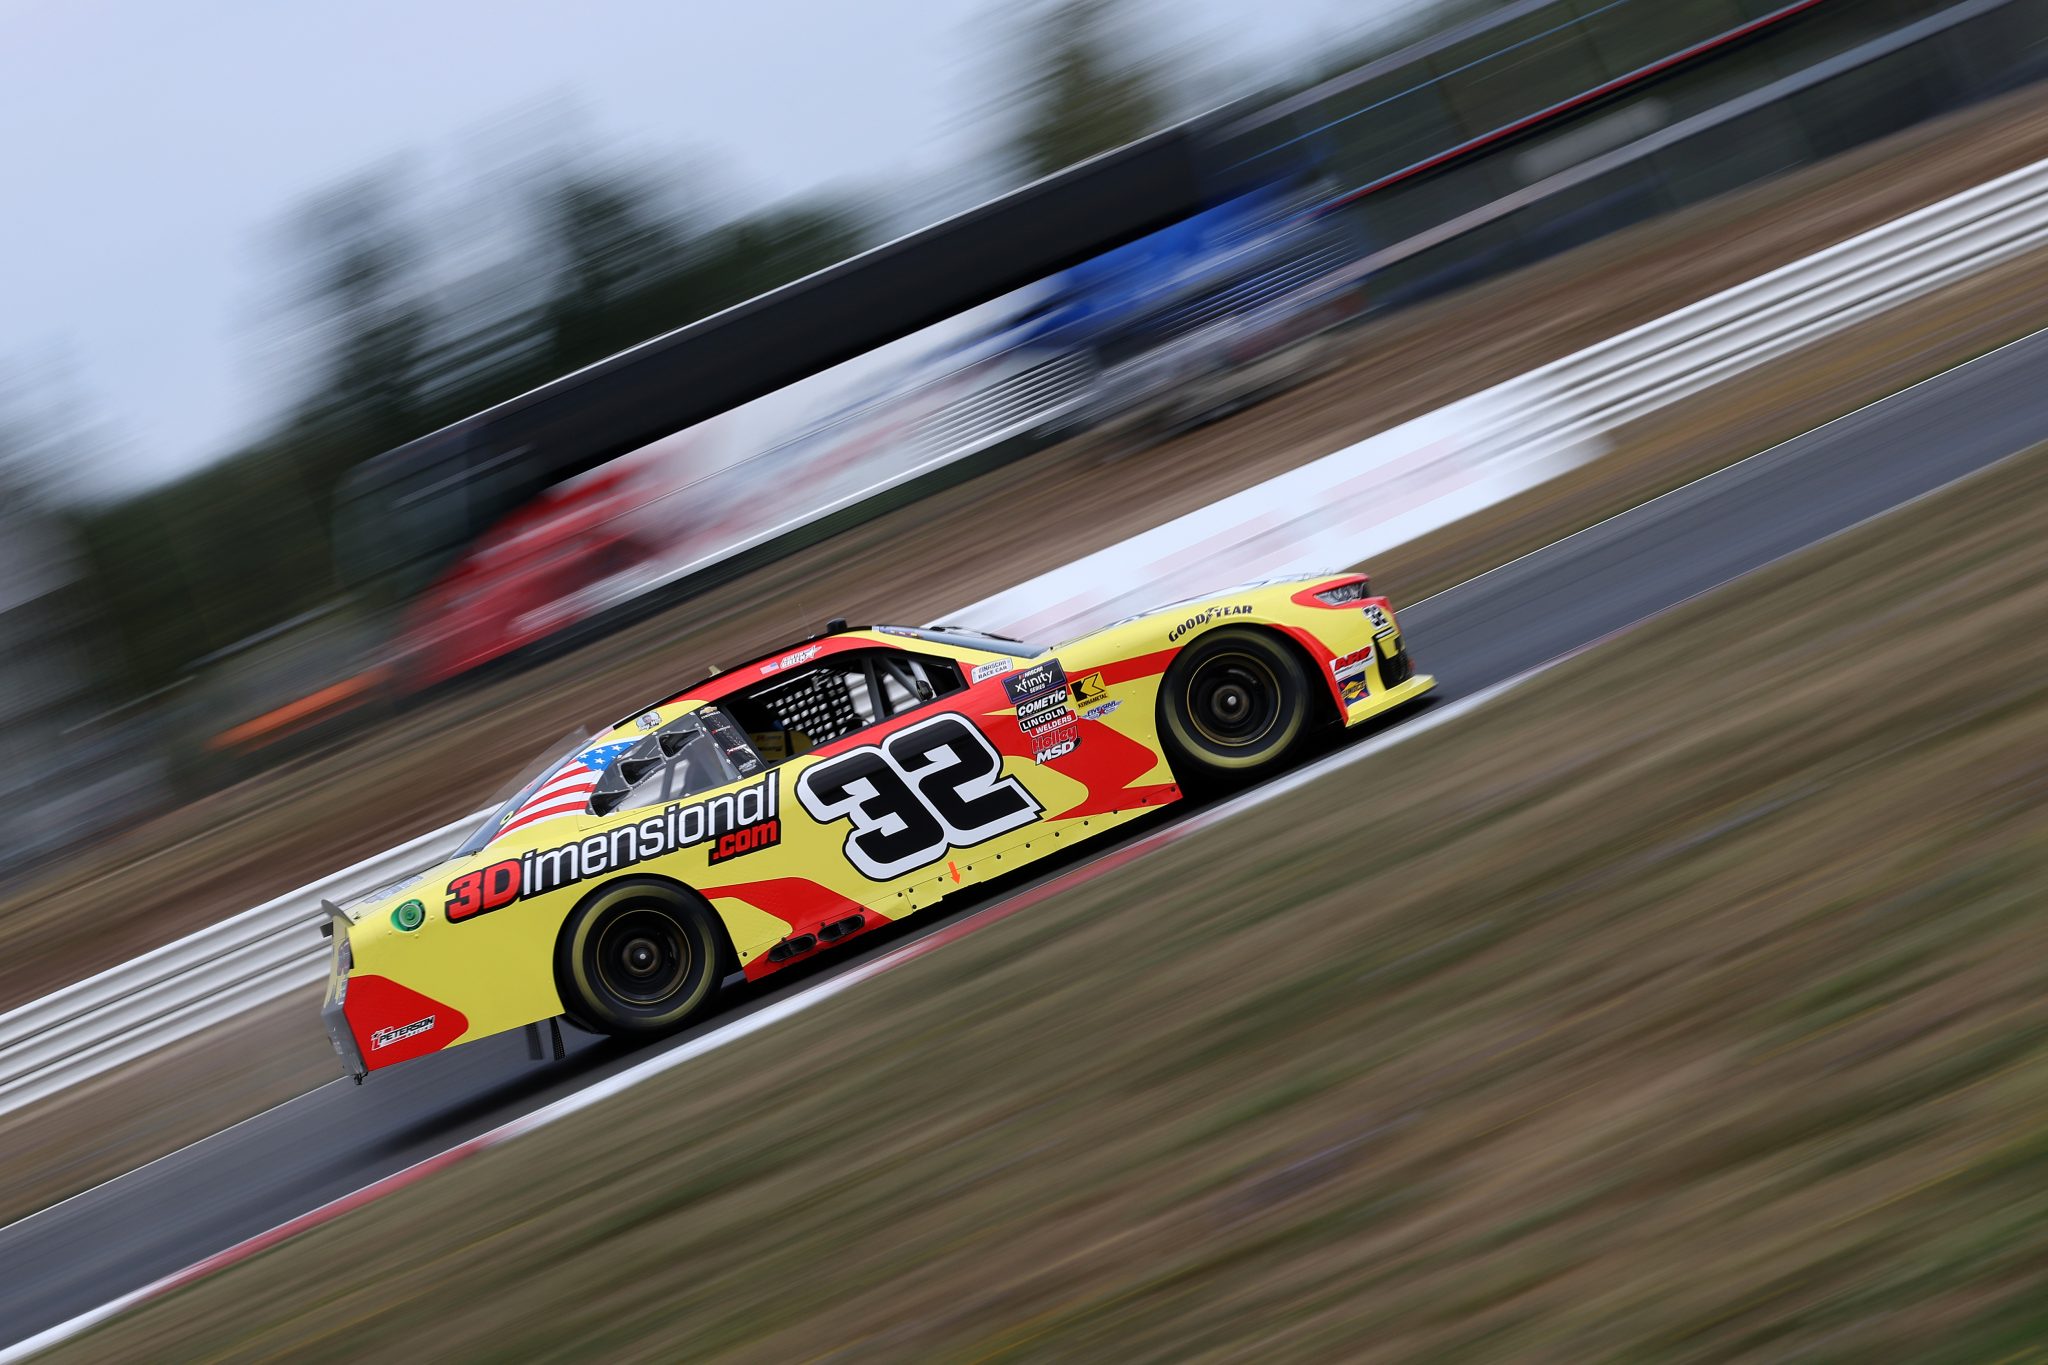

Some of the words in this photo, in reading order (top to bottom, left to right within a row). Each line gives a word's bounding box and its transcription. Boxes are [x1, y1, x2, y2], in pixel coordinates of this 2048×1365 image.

[1168, 605, 1253, 642] GOODYEAR
[978, 670, 995, 680] RACE
[994, 665, 1008, 675] CAR
[1014, 670, 1053, 693] xfinity
[1029, 683, 1046, 694] SERIES
[1022, 708, 1065, 730] LINCOLN
[1035, 714, 1073, 734] WELDERS
[1032, 726, 1078, 753] Holley
[1036, 741, 1075, 765] MSD
[795, 711, 1046, 882] 32
[446, 770, 777, 921] 3Dimensional
[712, 820, 778, 860] .com
[378, 1016, 434, 1043] PETERSON
